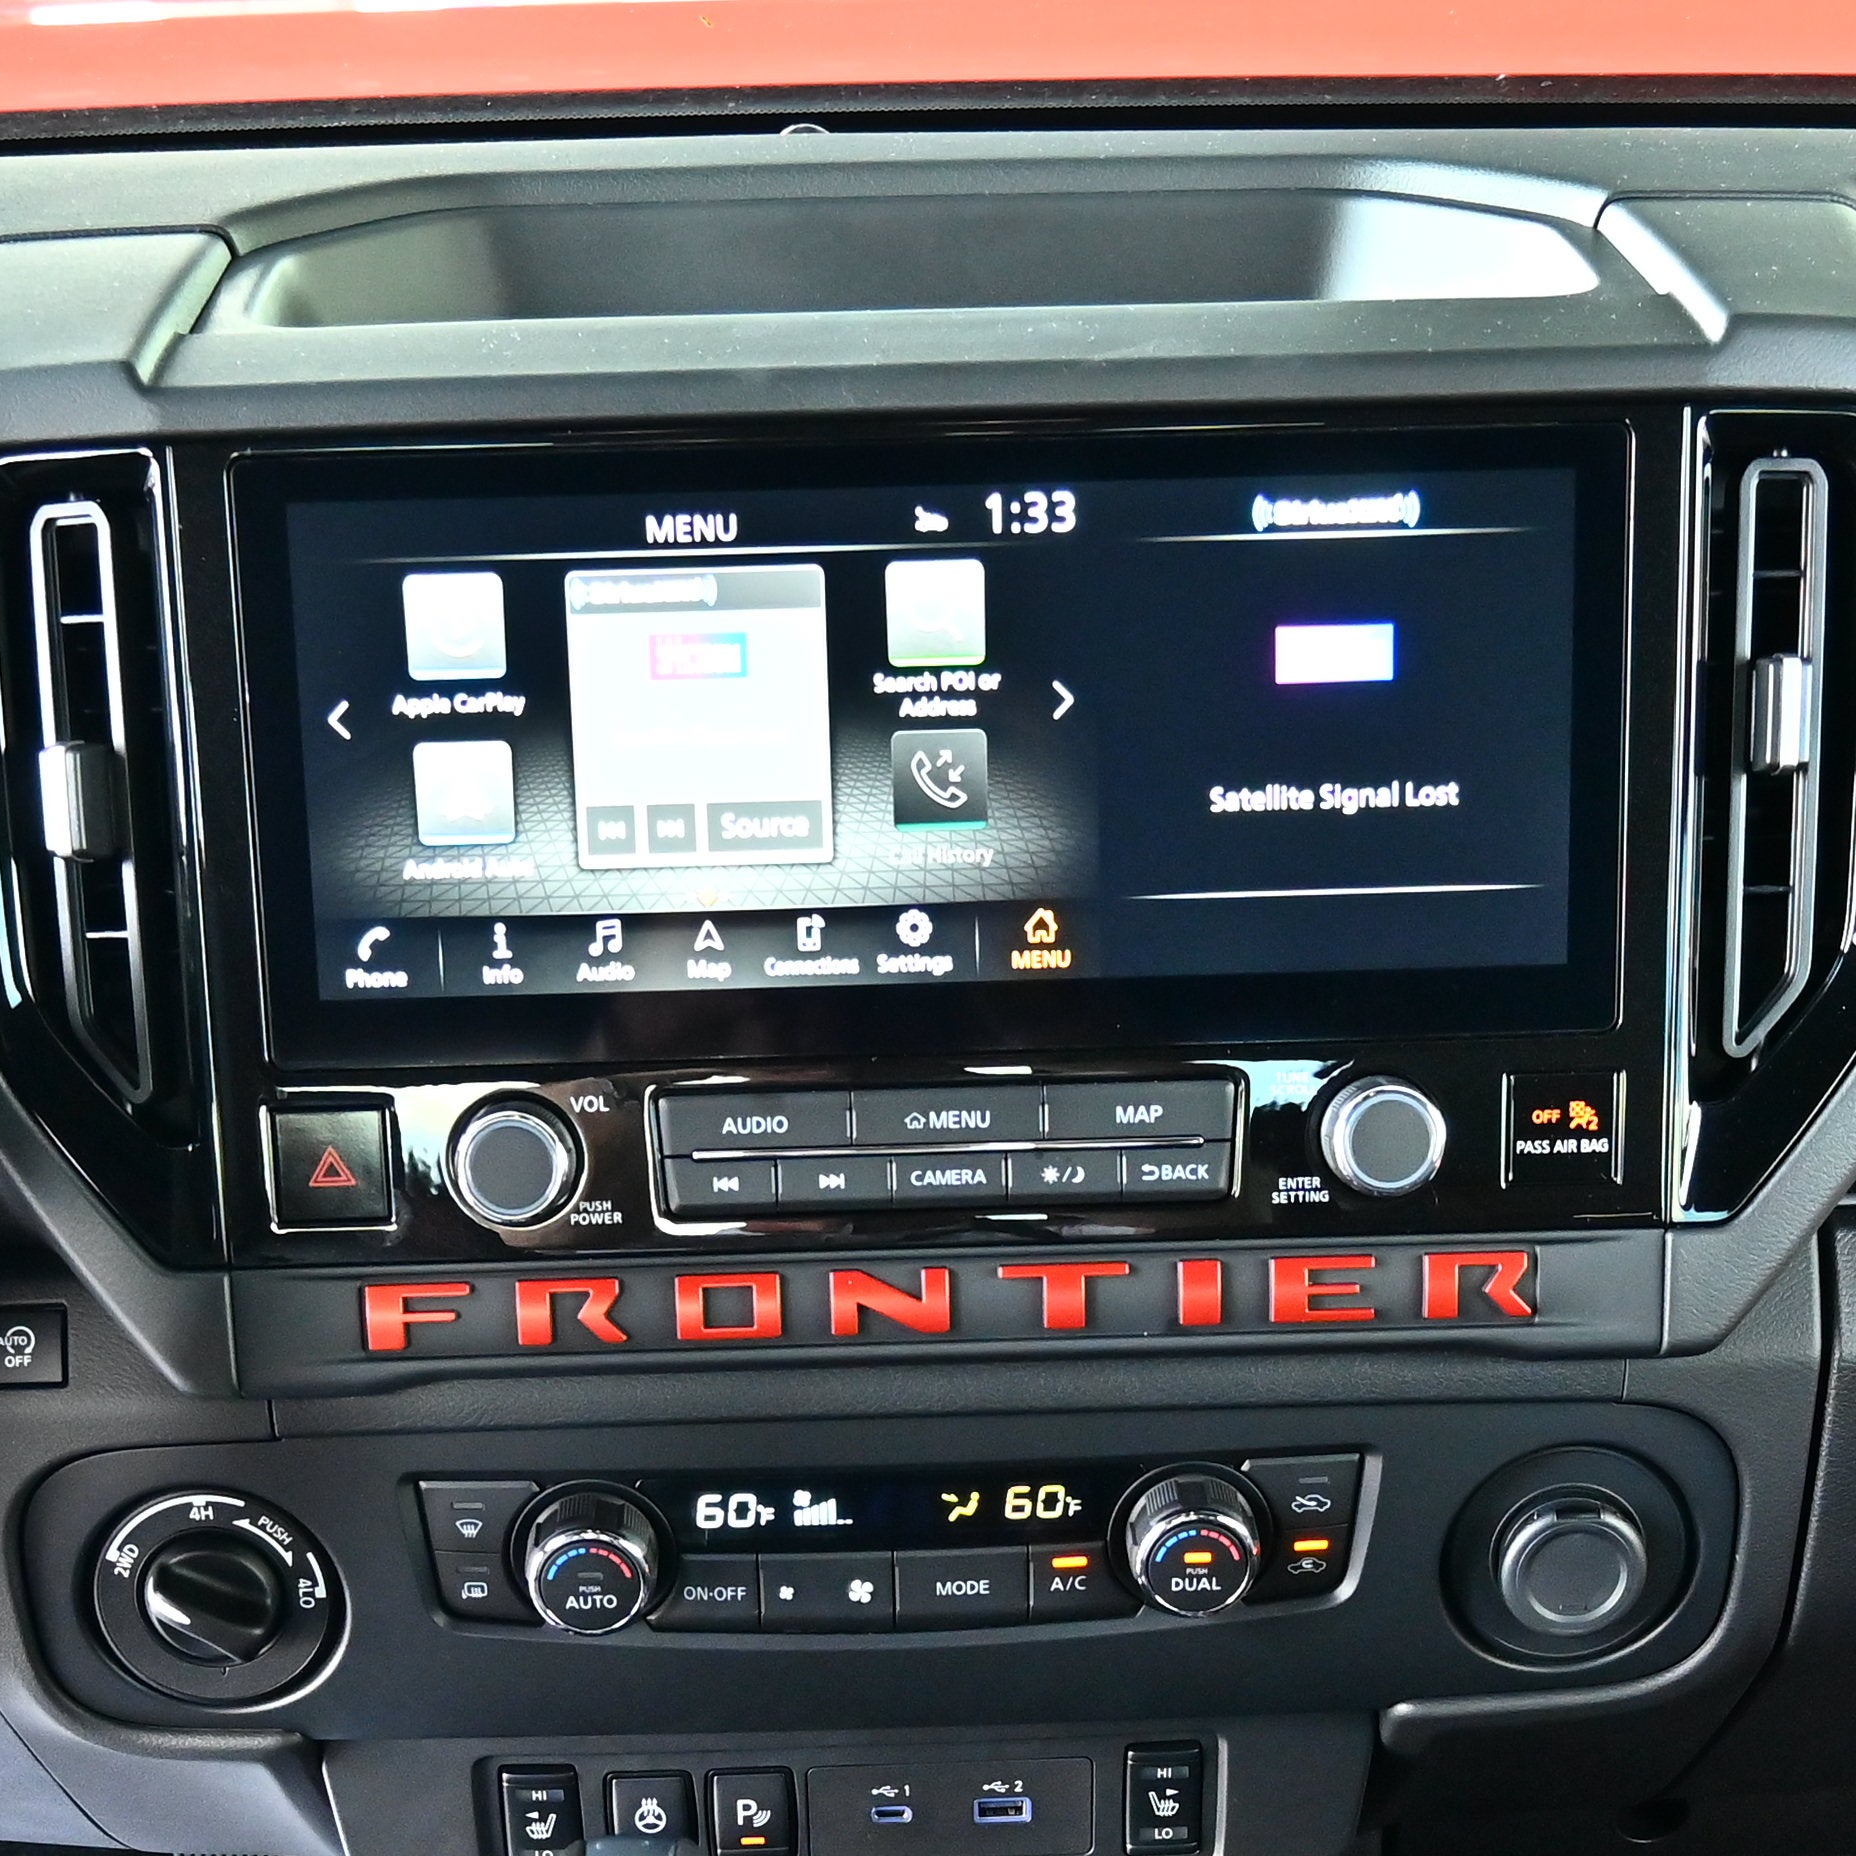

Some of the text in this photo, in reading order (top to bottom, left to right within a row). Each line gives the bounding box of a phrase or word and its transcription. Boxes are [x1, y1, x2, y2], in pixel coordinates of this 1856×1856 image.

[985, 490, 1076, 534] 1:33
[645, 513, 738, 543] MENU
[873, 670, 976, 693] Search POI
[392, 691, 526, 719] Apple CarPlay
[899, 696, 977, 717] Address
[1209, 780, 1460, 815] Satellite Signal Lost
[719, 811, 811, 840] Source
[763, 954, 860, 977] Connections
[877, 953, 954, 977] Settings
[1011, 949, 1072, 970] MENU
[345, 969, 408, 989] Phone
[482, 964, 524, 985] Info
[576, 961, 636, 982] Audio
[687, 959, 732, 982] Map
[570, 1097, 610, 1112] VOL
[929, 1110, 991, 1129] MENU
[1115, 1105, 1163, 1124] MAP
[1532, 1109, 1561, 1124] OFF
[722, 1115, 789, 1135] AUDIO
[1516, 1138, 1608, 1154] PASS AIR BAG
[910, 1168, 987, 1187] CAMERA
[1161, 1164, 1209, 1181] BACK
[1278, 1177, 1321, 1190] ENTER
[578, 1200, 613, 1213] PUSH
[1271, 1190, 1329, 1204] SETTING
[569, 1210, 623, 1226] POWER
[363, 1251, 1534, 1351] FRONTIER
[4, 1354, 32, 1368] OFF
[189, 1505, 215, 1522] 4H
[257, 1515, 294, 1546] PUSH
[113, 1542, 140, 1579] 2WD
[297, 1577, 315, 1610] 4LO
[935, 1579, 990, 1597] MODE
[1050, 1575, 1087, 1593] A/C
[1170, 1576, 1222, 1593] DUAL
[565, 1594, 618, 1610] AUTO
[1156, 1767, 1172, 1779] HI
[532, 1790, 547, 1801] HI
[1154, 1827, 1173, 1840] LO
